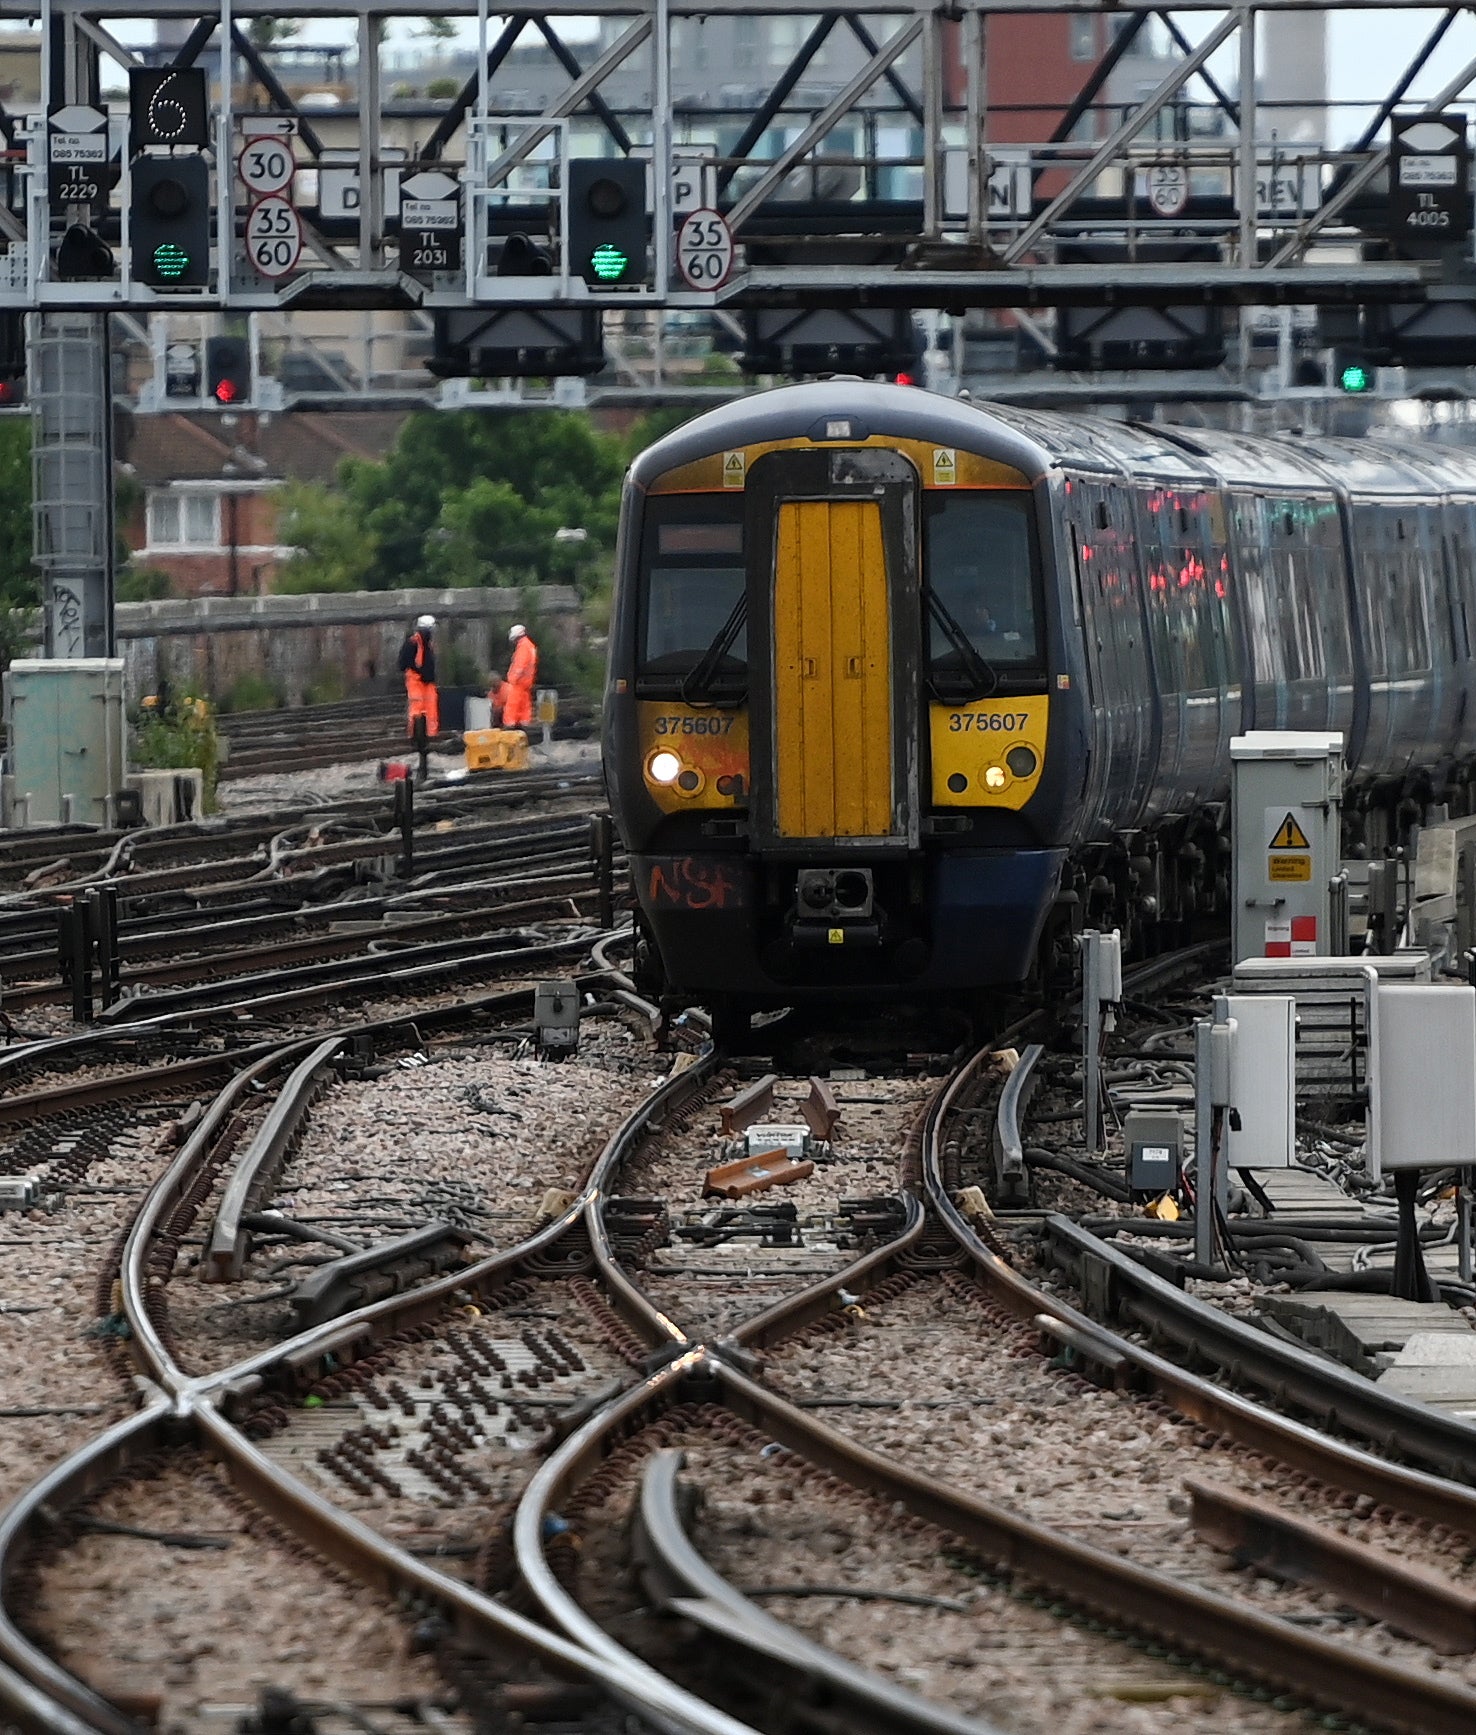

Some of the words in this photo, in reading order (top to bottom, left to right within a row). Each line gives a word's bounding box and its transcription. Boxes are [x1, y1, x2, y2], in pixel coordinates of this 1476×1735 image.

[148, 72, 186, 138] 6
[68, 165, 89, 180] TL
[250, 153, 285, 179] 30
[59, 183, 98, 199] 2229
[1416, 193, 1440, 208] TL
[257, 207, 291, 234] 35
[1406, 211, 1450, 226] 4005
[419, 231, 440, 247] TL
[688, 221, 722, 247] 35
[256, 240, 291, 267] 60
[413, 249, 447, 265] 2031
[687, 254, 722, 279] 60
[654, 716, 735, 735] 375607
[949, 713, 1029, 732] 375607
